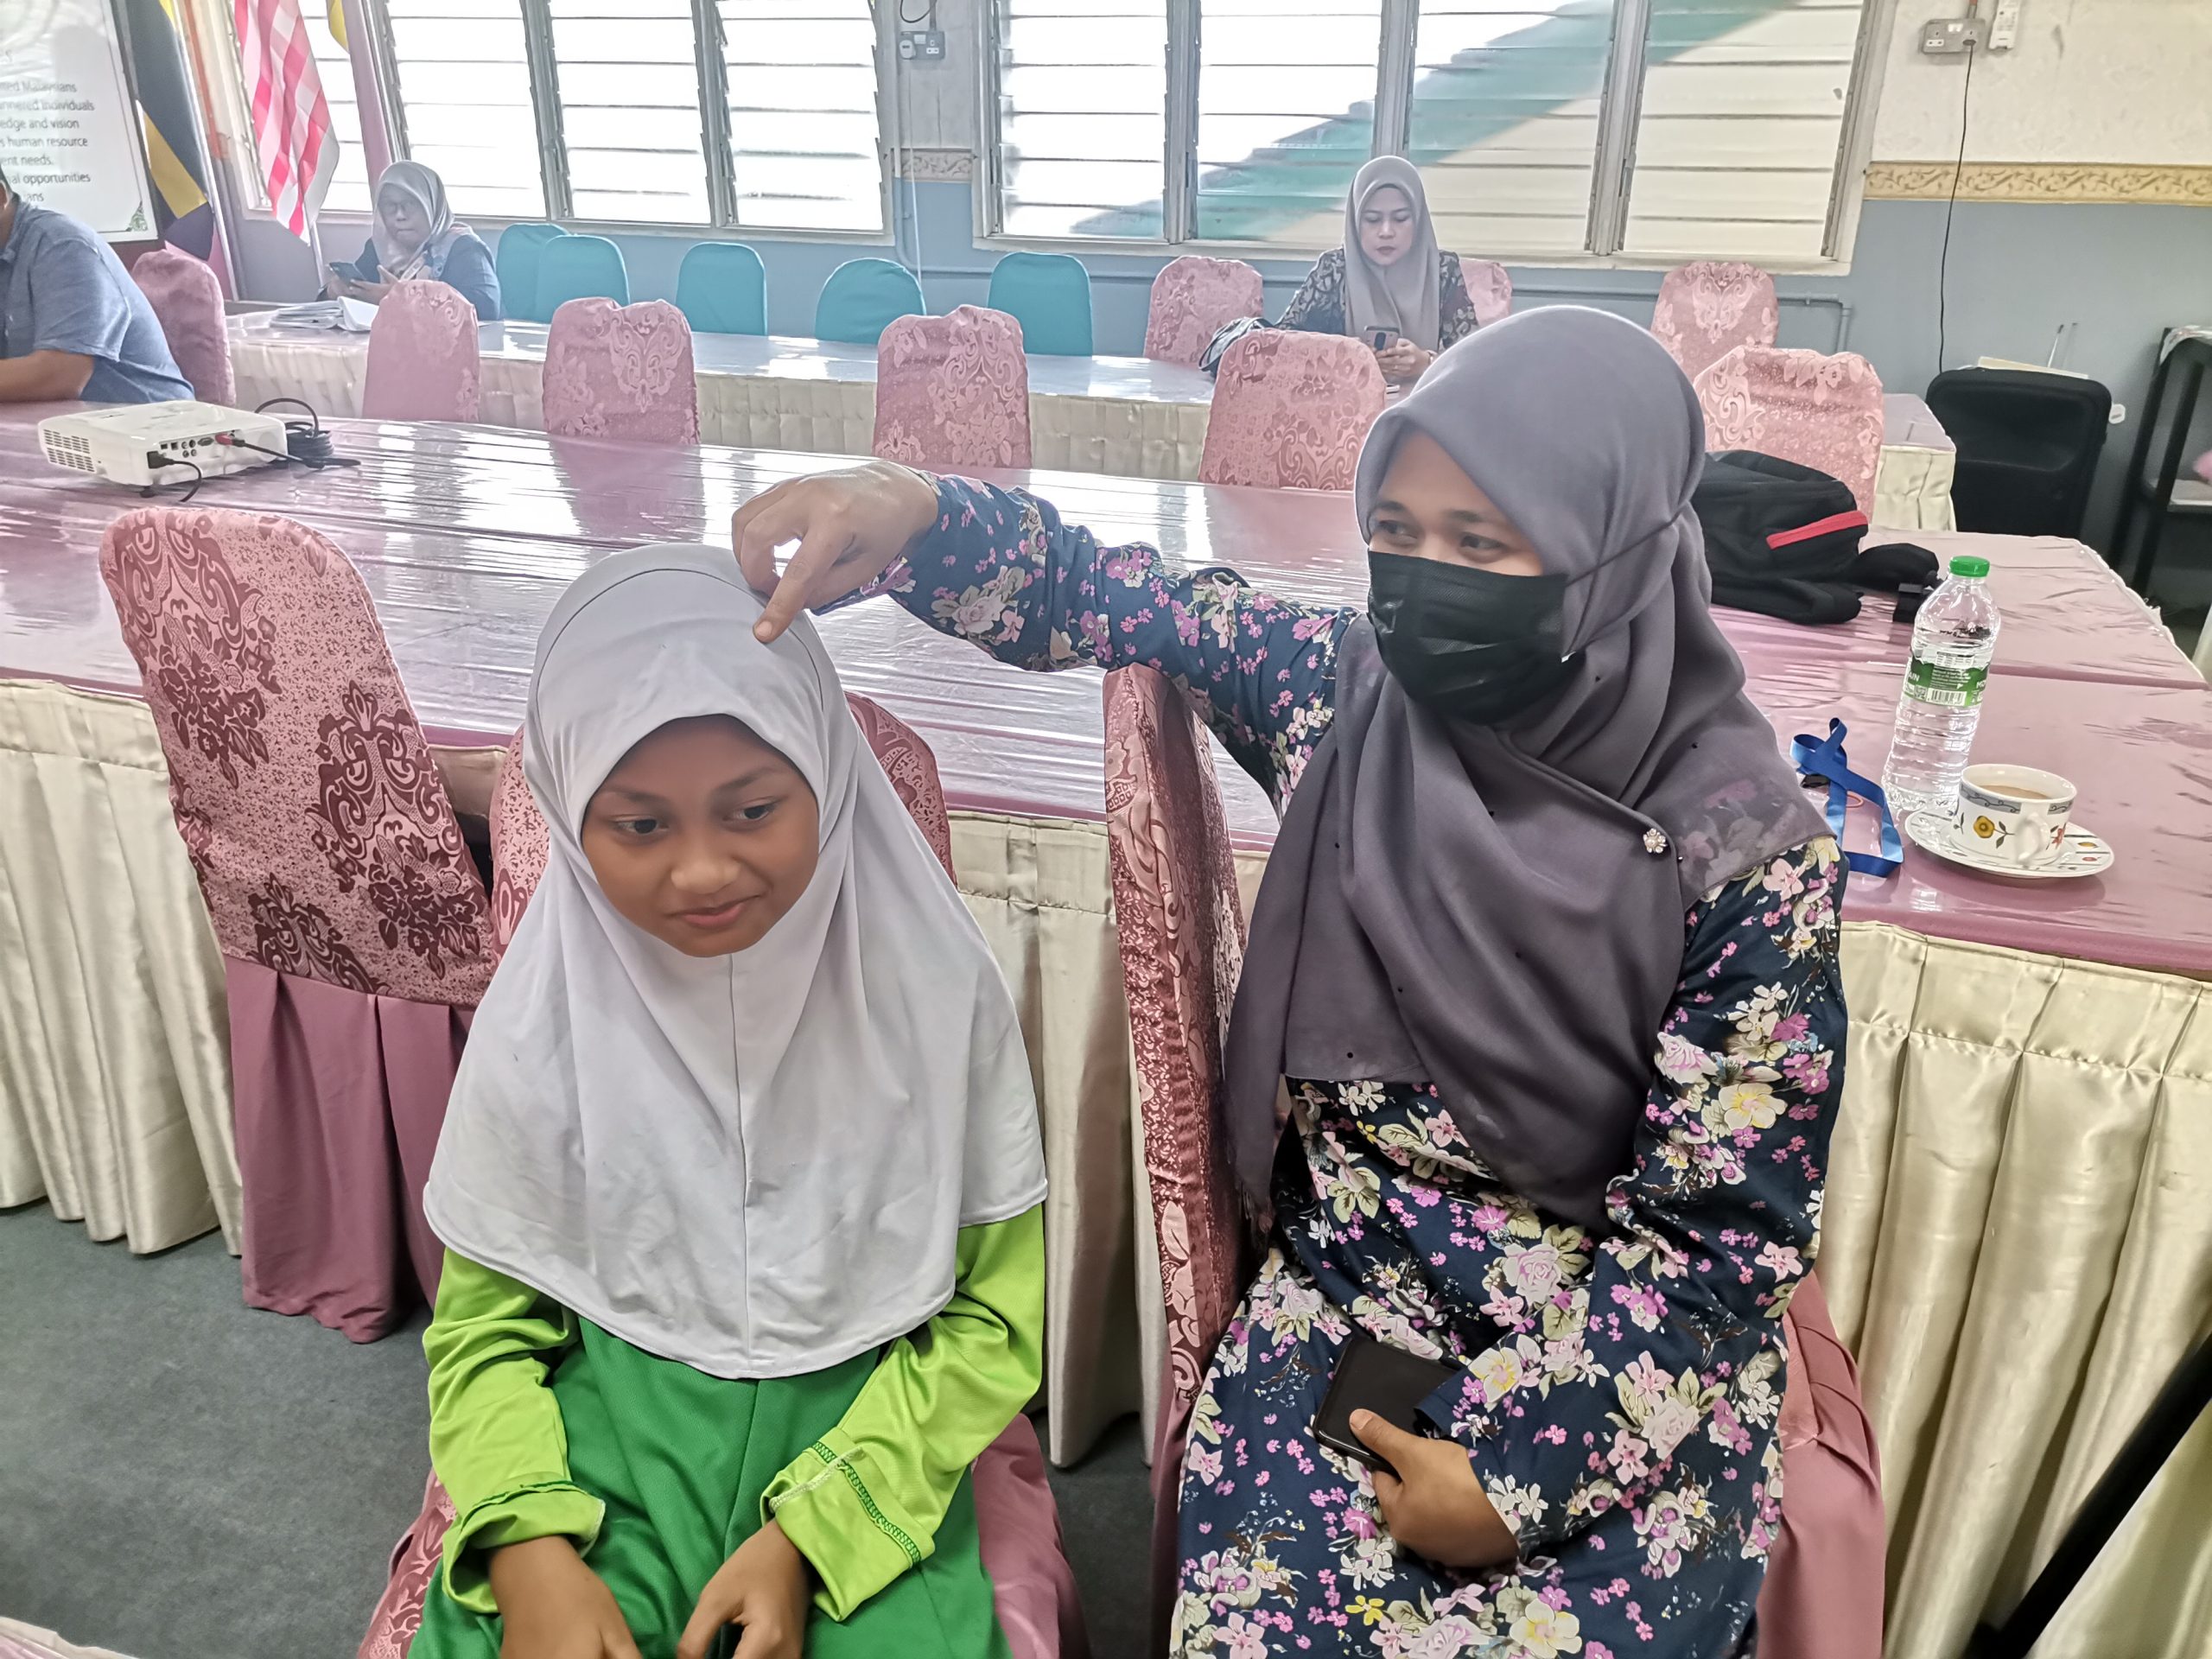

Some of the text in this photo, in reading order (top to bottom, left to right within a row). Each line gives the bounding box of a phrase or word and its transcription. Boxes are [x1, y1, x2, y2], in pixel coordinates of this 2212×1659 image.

[29, 118, 48, 129] and
[50, 118, 79, 129] vision
[7, 136, 44, 147] human
[46, 137, 88, 147] resource
[22, 174, 91, 186] opportunities
